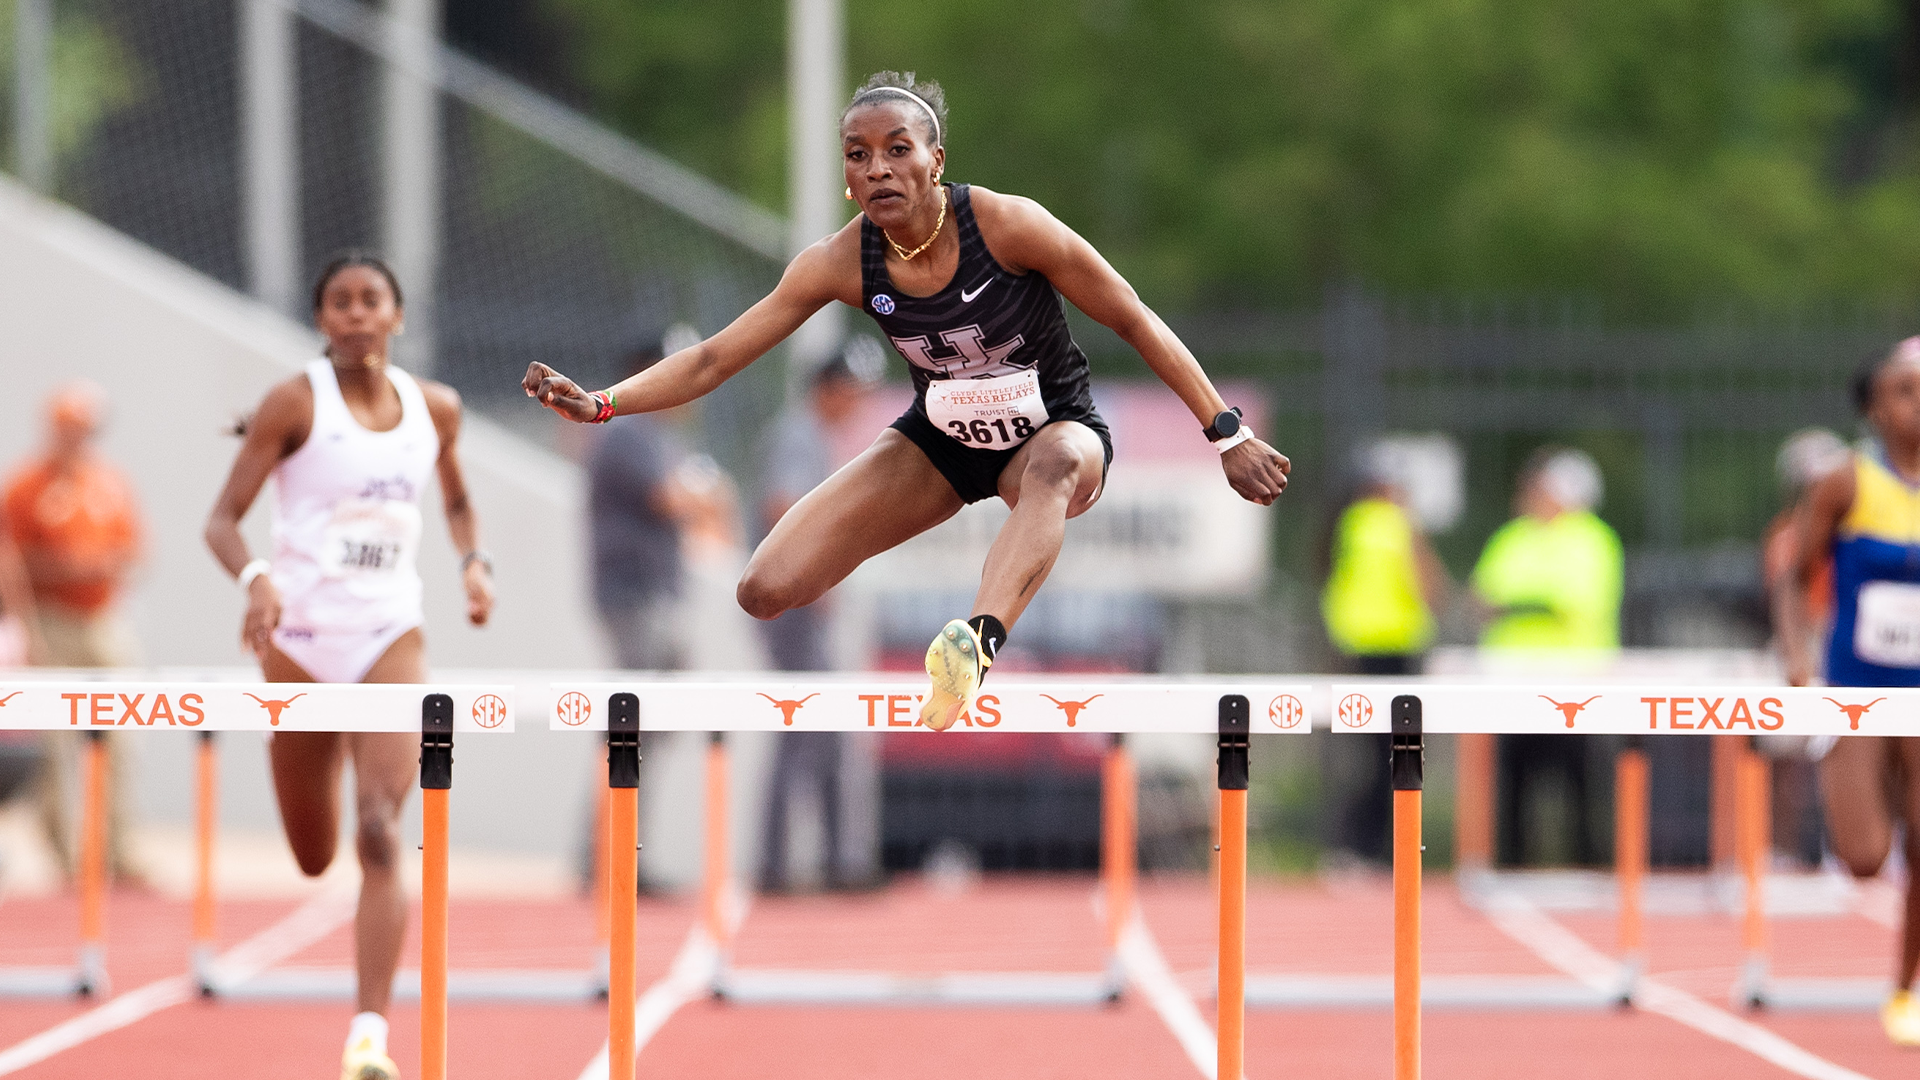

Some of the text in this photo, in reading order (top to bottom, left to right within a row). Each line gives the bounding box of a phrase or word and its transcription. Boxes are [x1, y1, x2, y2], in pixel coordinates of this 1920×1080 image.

[950, 381, 1034, 397] CLYDE LITTLEFIELD
[951, 387, 1036, 405] TEXAS RELAYS
[974, 409, 1006, 417] TRUIST
[948, 416, 1036, 444] 3618
[61, 693, 205, 726] TEXAS
[472, 694, 506, 728] SEC
[557, 692, 591, 726] SEC
[858, 694, 1002, 728] TES
[1269, 694, 1303, 729] SEC
[1338, 693, 1373, 728] SEC
[1641, 697, 1784, 730] TEXAS
